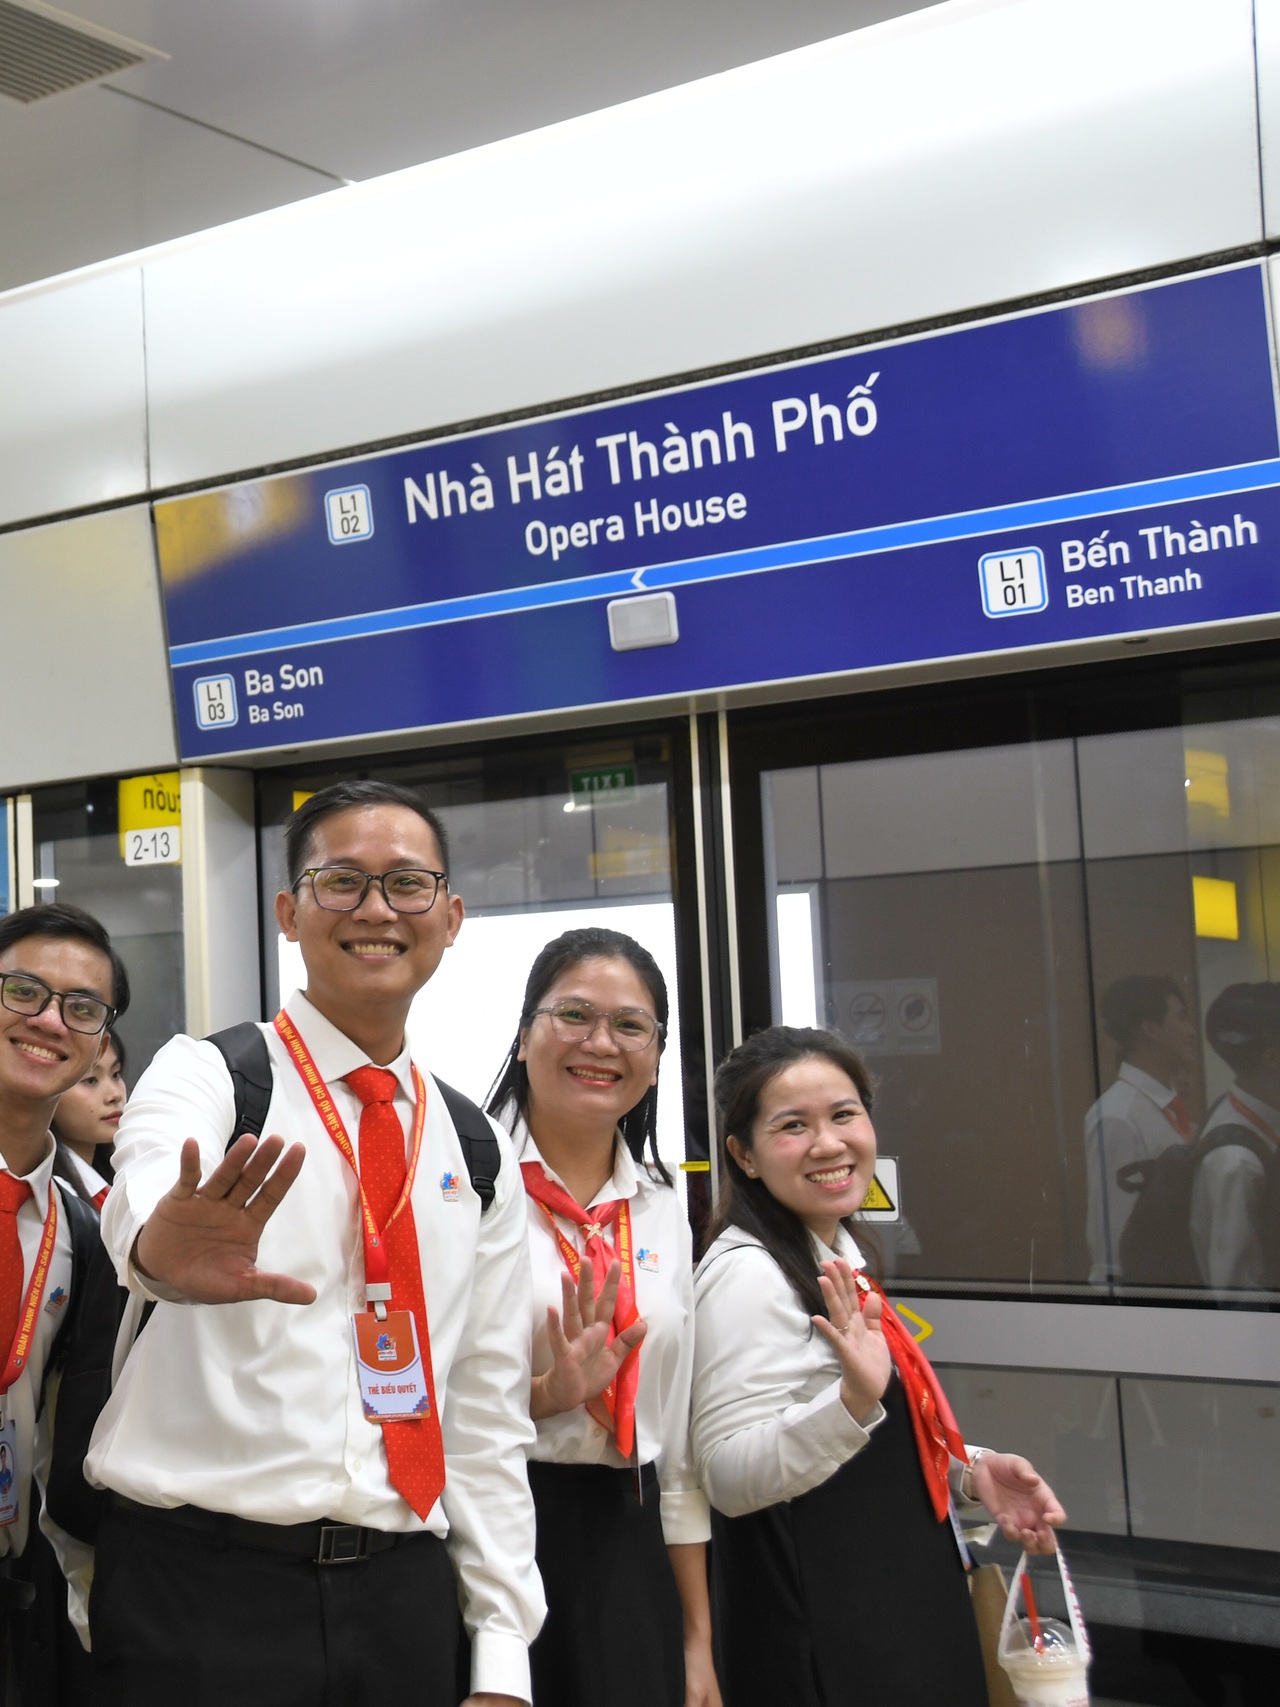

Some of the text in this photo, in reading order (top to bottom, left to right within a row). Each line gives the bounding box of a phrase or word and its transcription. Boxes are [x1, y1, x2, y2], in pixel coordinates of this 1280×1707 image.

[403, 373, 882, 524] Nhà Hát Thành Phố
[339, 494, 357, 514] L1
[341, 515, 361, 534] 02
[525, 491, 748, 560] Opera House
[1061, 513, 1259, 573] Bến Thành
[1000, 558, 1025, 582] L1
[1003, 583, 1027, 606] 01
[1066, 568, 1203, 608] Ben Thanh
[244, 663, 324, 696] Ba Son
[206, 683, 223, 702] L1
[208, 703, 226, 721] 03
[248, 701, 304, 724] Ba Son
[132, 831, 171, 861] 2-13
[302, 1062, 320, 1085] MINH
[619, 1225, 629, 1250] UNION
[620, 1250, 630, 1262] OF
[620, 1262, 631, 1274] HO
[22, 1306, 35, 1333] THANH
